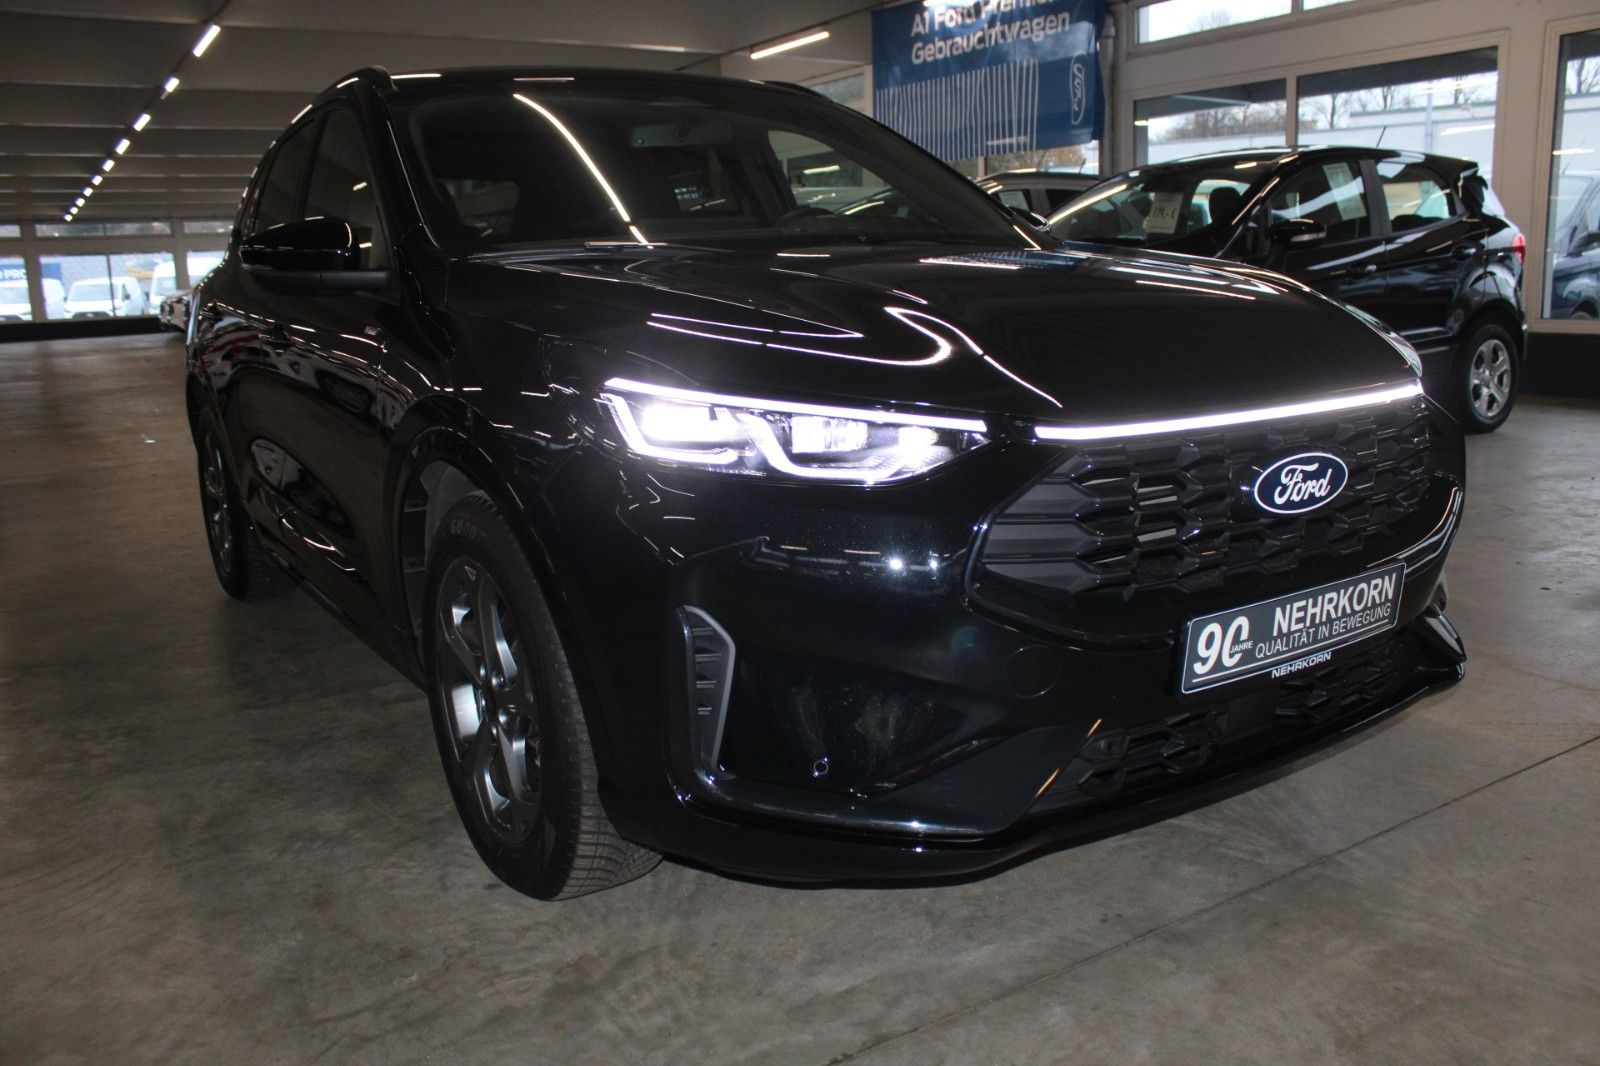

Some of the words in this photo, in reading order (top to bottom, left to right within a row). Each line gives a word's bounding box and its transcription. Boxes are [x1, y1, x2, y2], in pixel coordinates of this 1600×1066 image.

[911, 12, 1070, 65] Gebrauchtwagen
[1274, 463, 1333, 505] Ford
[1273, 573, 1397, 637] NEHRKORN
[1229, 640, 1254, 654] JAHRE
[1255, 626, 1316, 659] QUALITÄT
[1317, 623, 1330, 640] IN
[1332, 603, 1392, 635] BEWEGUNG
[1271, 651, 1333, 679] NEHRKORN
